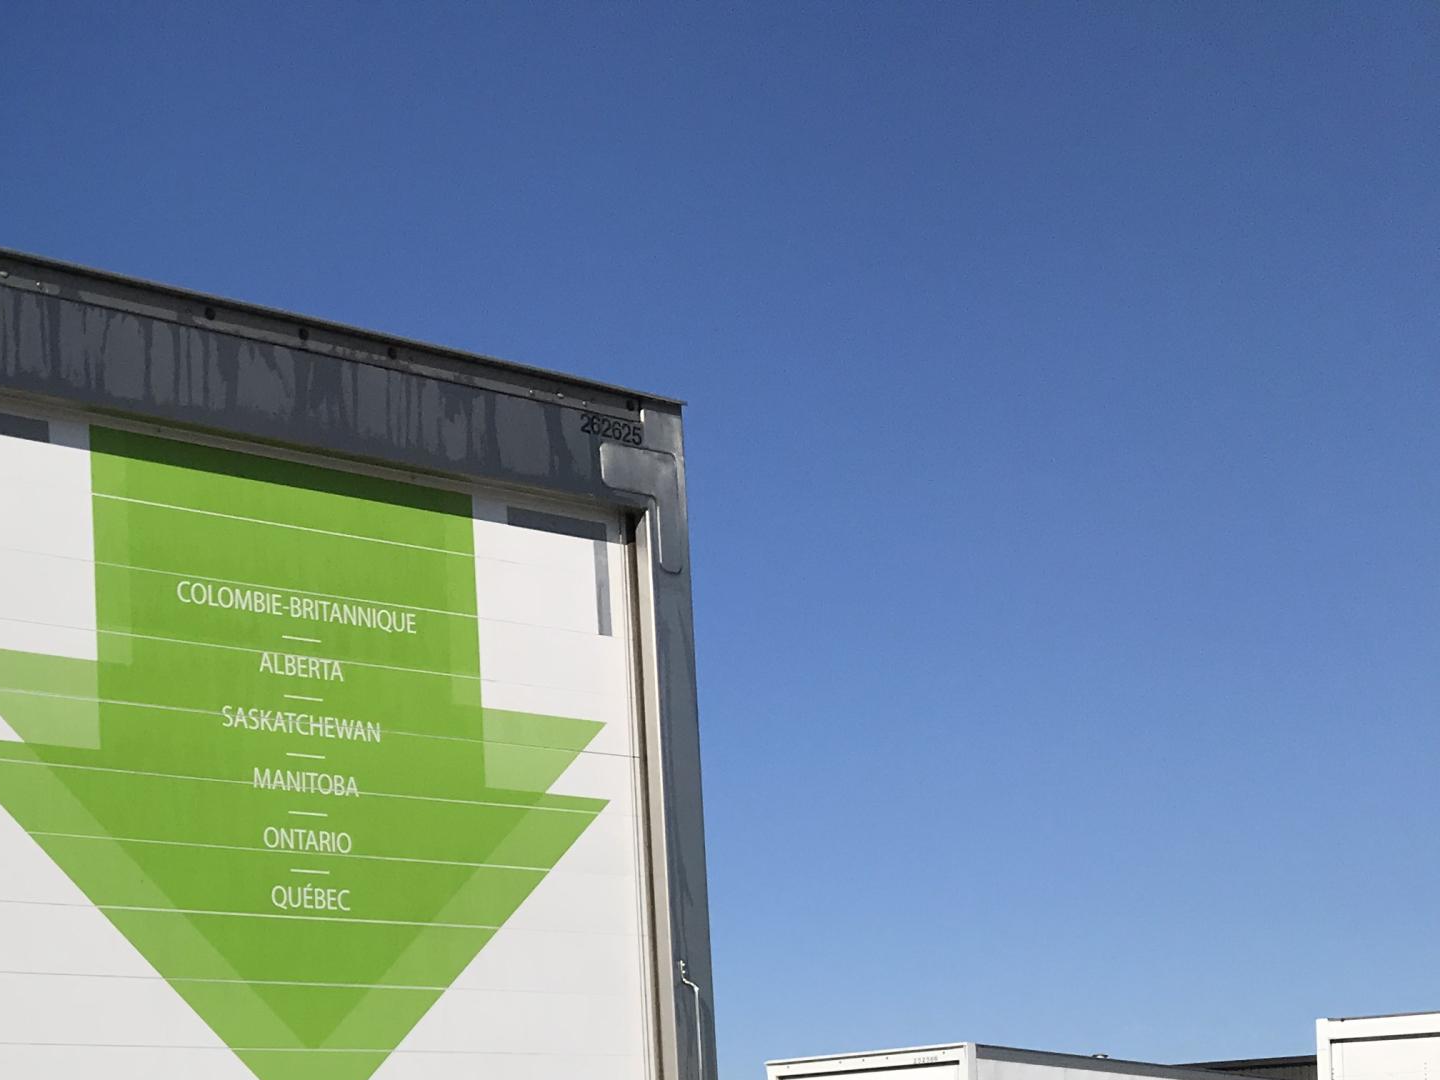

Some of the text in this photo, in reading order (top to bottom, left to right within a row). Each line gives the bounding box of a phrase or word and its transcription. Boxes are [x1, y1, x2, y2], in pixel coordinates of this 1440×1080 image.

[580, 413, 643, 445] 262625
[176, 580, 417, 634] COLOMBIE-BRITANNIQUE
[260, 651, 344, 682] ALBERTA
[221, 705, 381, 743] SASKATCHEWAN
[253, 767, 359, 798] MANITOBA
[263, 826, 353, 855] ONTARIO
[271, 883, 351, 911] QUÉBEC
